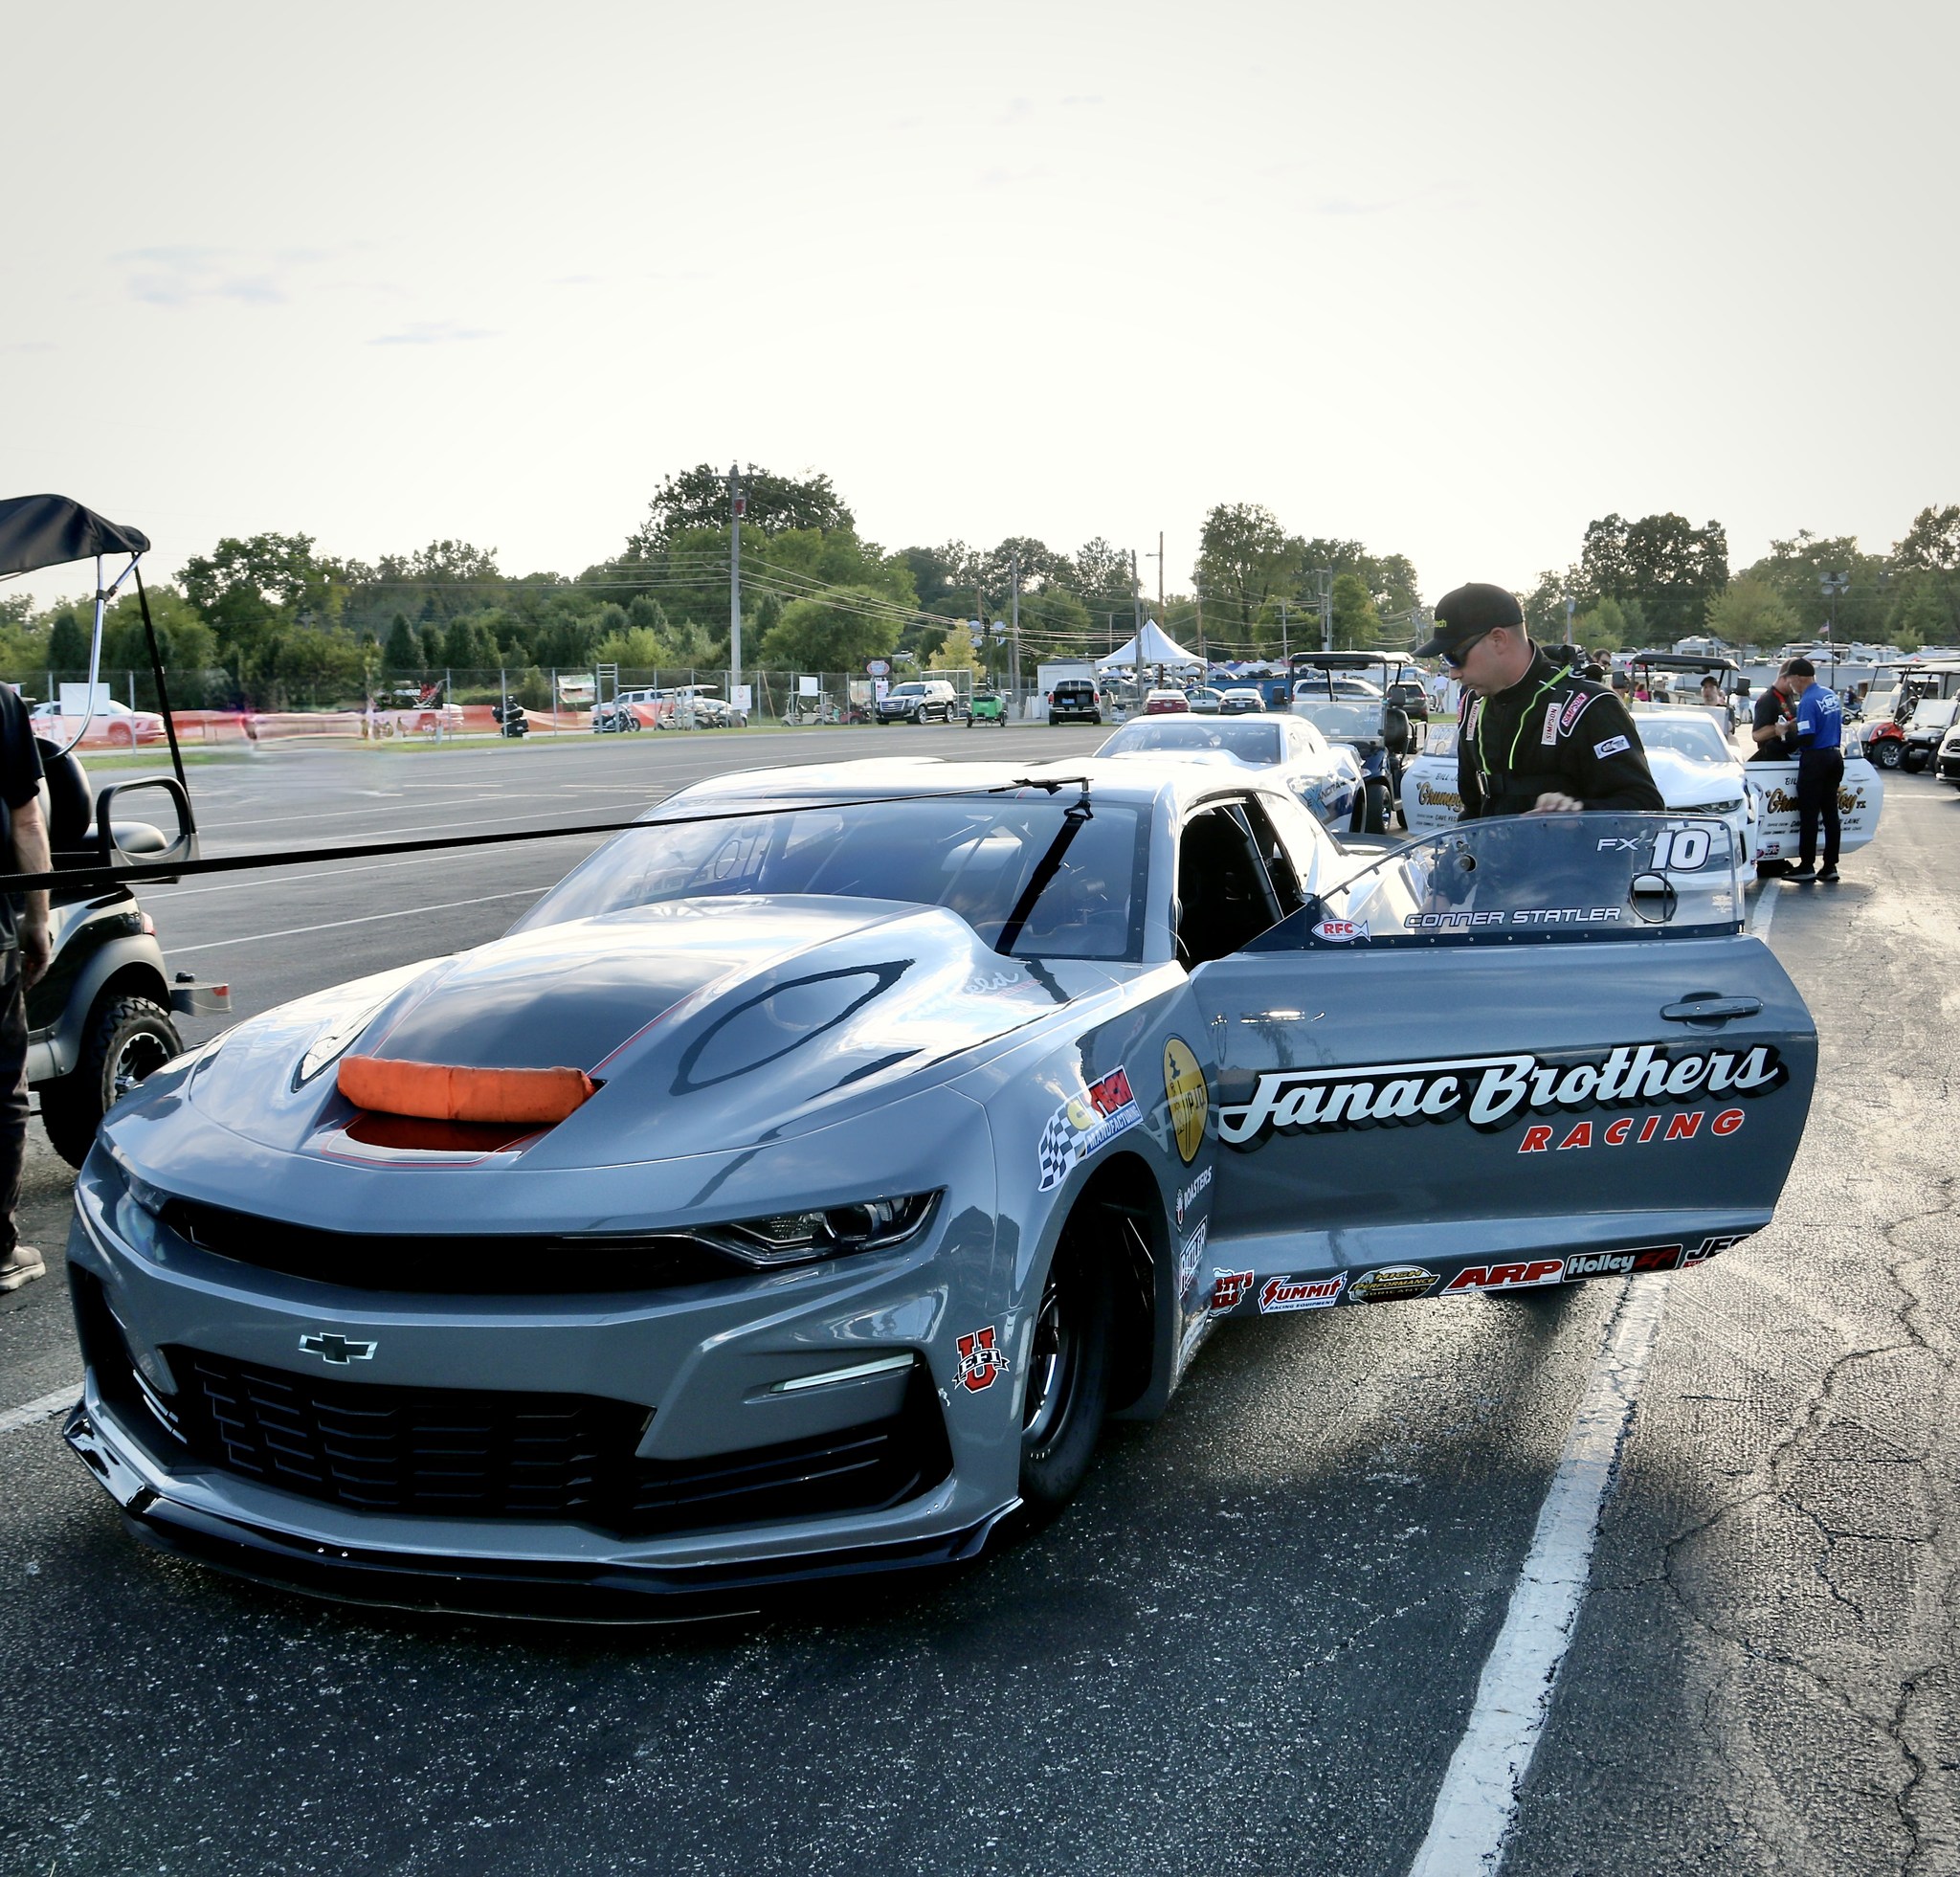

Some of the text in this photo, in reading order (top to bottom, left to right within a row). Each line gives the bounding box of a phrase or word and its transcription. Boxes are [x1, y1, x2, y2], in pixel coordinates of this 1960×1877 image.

[1546, 707, 1558, 740] SIMPSON
[1562, 694, 1587, 726] SIMPSON
[1596, 827, 1711, 872] FX 10
[1324, 923, 1354, 934] RFC
[1404, 905, 1622, 928] CONNER STATLER
[1218, 1057, 1463, 1145] Janac
[1468, 1045, 1779, 1126] Brothers
[1085, 1104, 1142, 1150] MANUFACTURING
[1516, 1108, 1747, 1154] RACING
[1184, 1165, 1213, 1211] ROASTERS
[1375, 1269, 1423, 1281] HIGH
[1449, 1261, 1564, 1289] ARP
[1568, 1254, 1636, 1275] Holley
[1354, 1277, 1437, 1292] PERFORMANCE
[1296, 1300, 1334, 1308] EQUIPMENT
[957, 1327, 997, 1393] U
[960, 1351, 999, 1375] EFI
